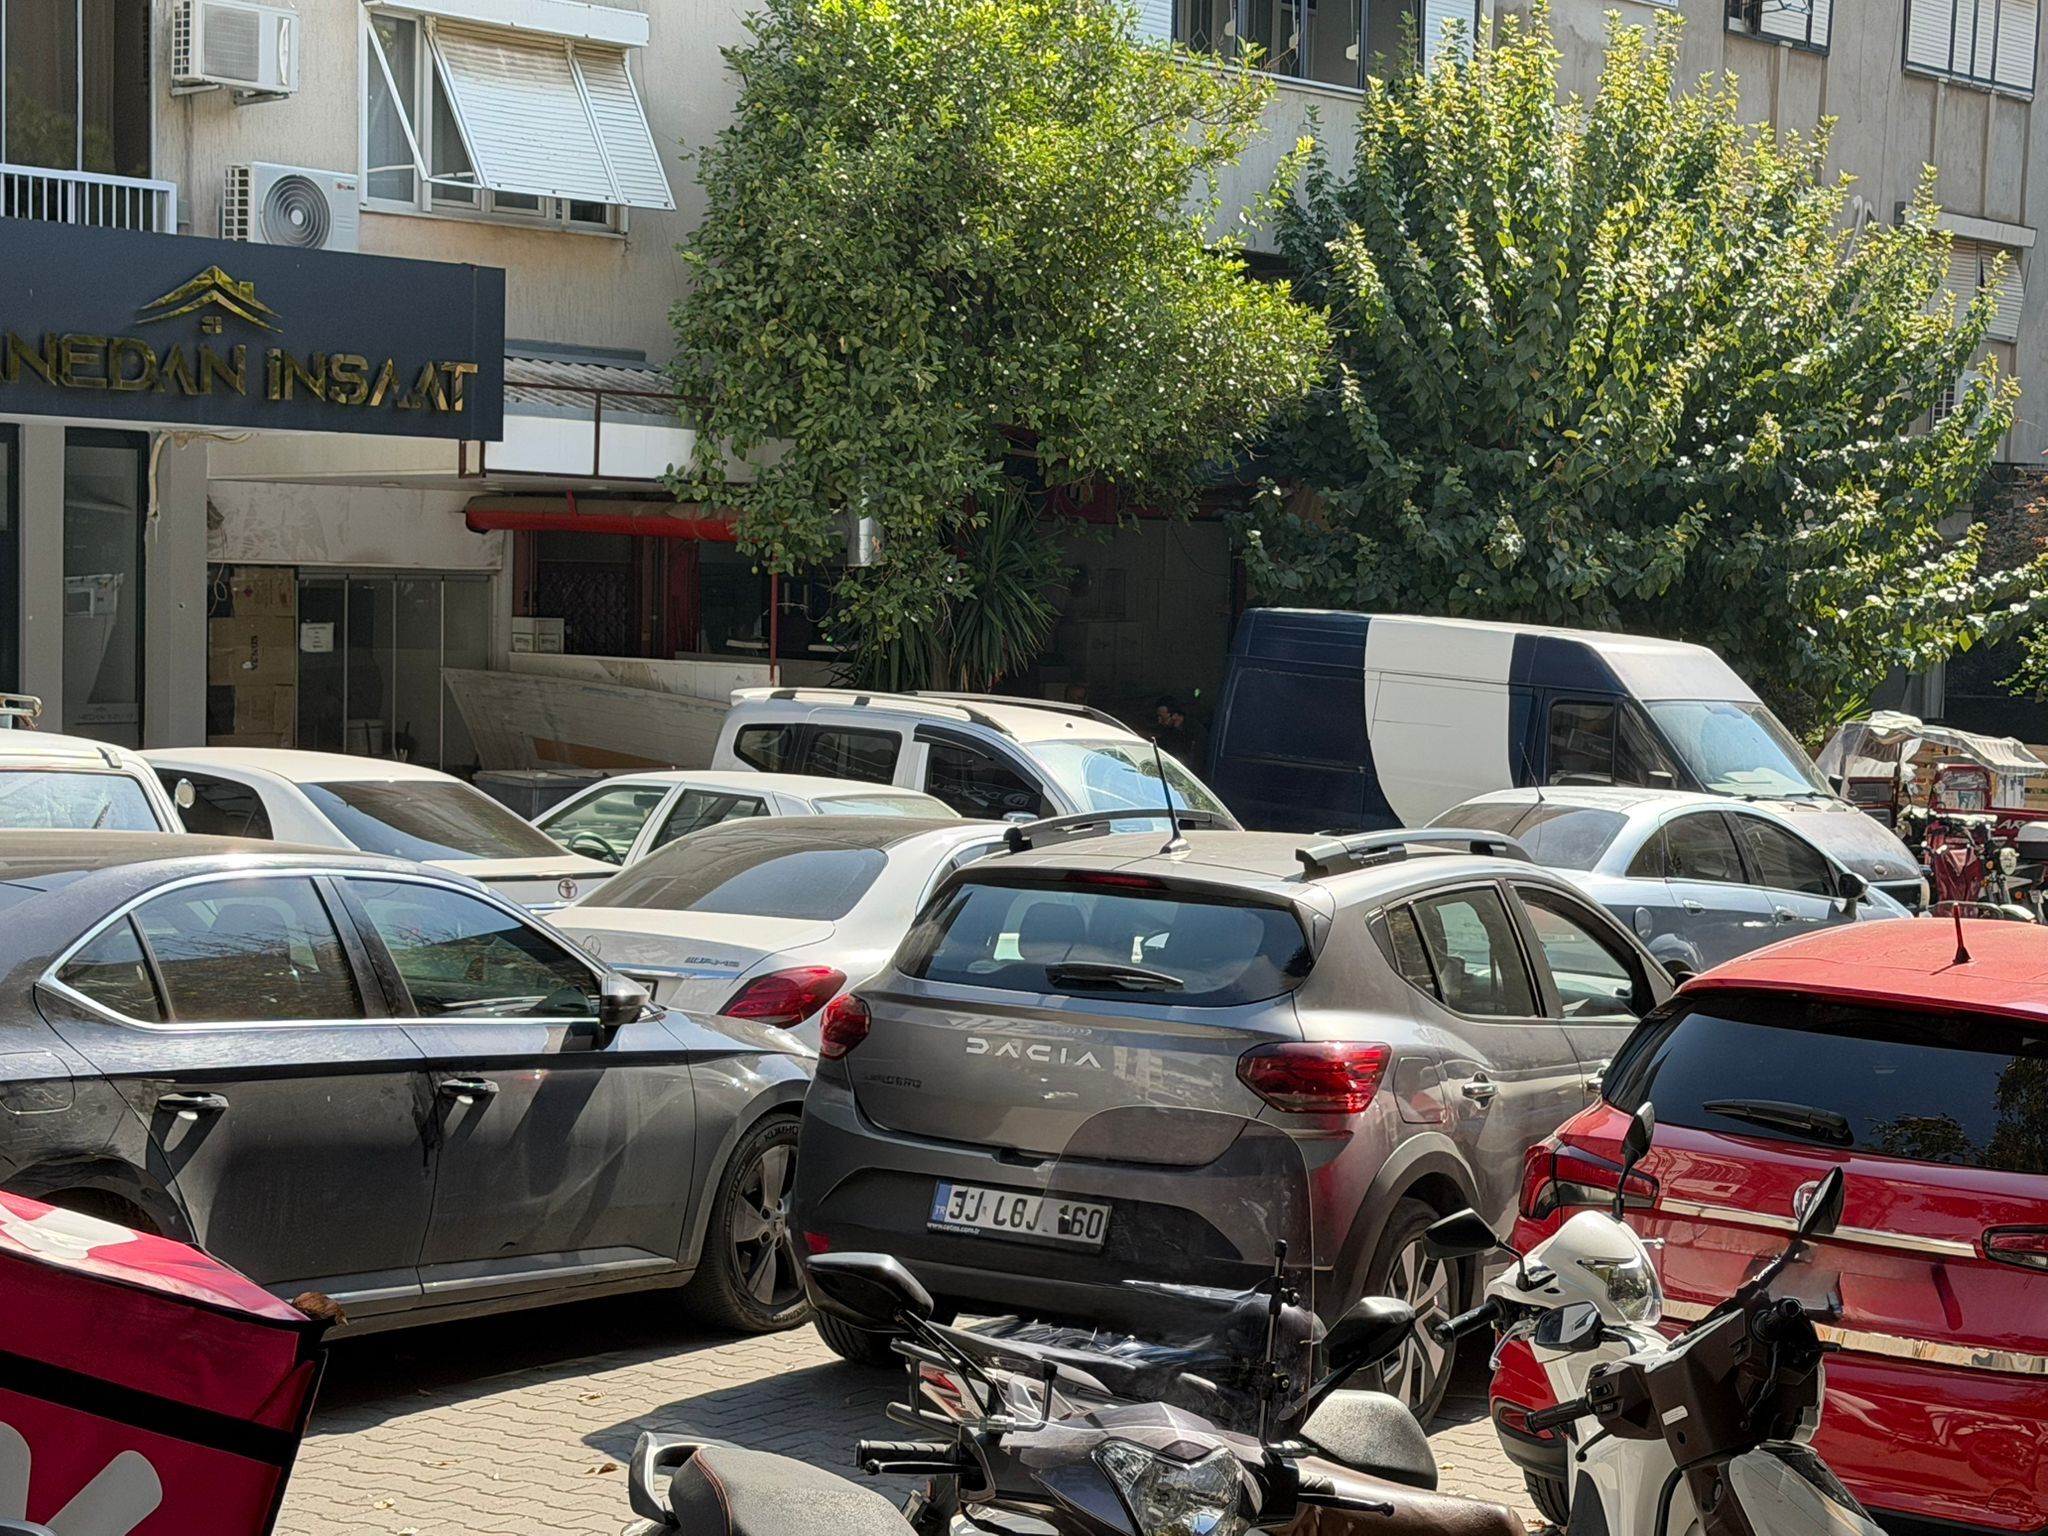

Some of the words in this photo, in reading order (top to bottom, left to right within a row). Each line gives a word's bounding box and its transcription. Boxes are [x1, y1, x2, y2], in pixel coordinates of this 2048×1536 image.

[0, 330, 247, 396] NEDAN
[966, 1037, 1101, 1069] DACIA
[935, 1205, 946, 1215] TR
